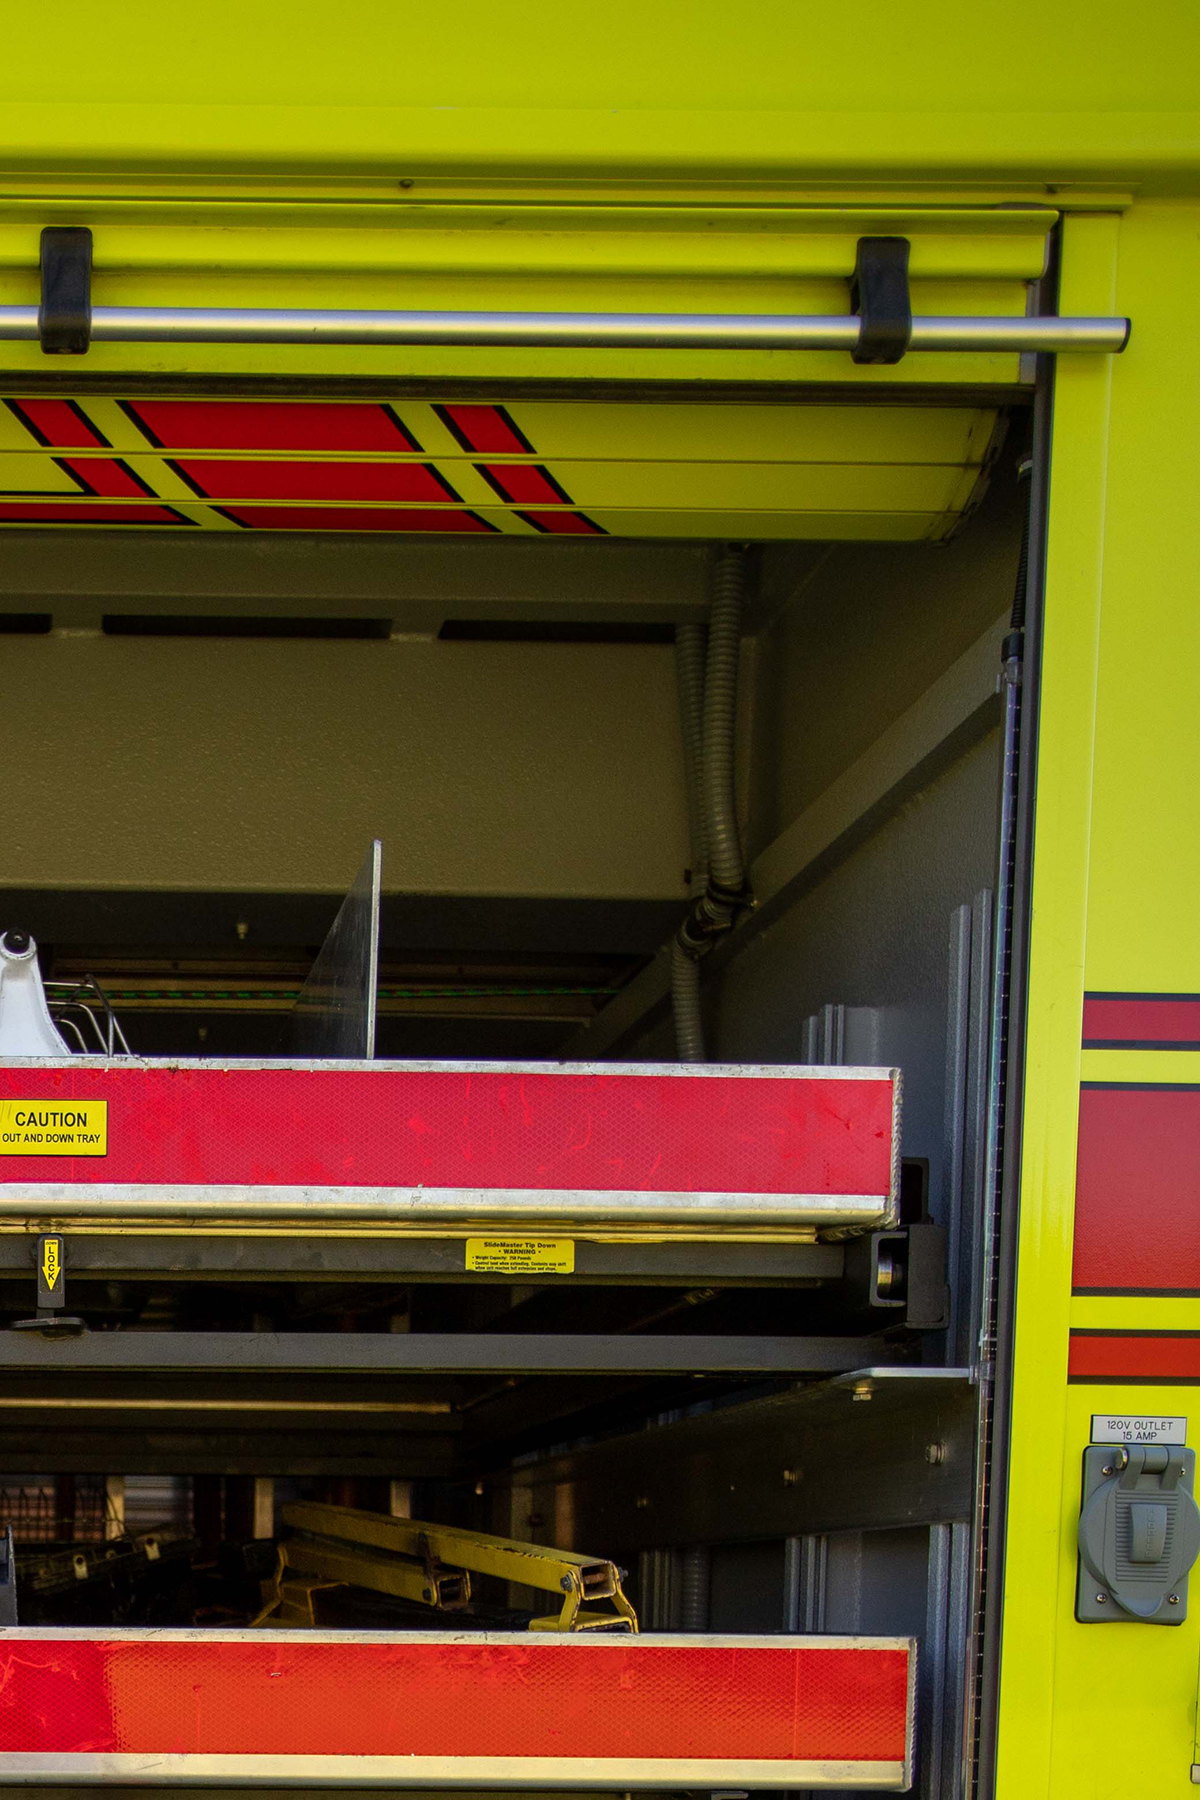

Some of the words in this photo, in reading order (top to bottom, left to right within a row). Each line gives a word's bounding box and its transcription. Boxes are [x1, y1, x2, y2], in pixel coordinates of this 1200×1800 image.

[15, 1112, 88, 1127] CAUTION
[2, 1133, 21, 1142] OUT
[23, 1133, 43, 1143] AND
[46, 1134, 74, 1143] DOWN
[77, 1134, 101, 1143] TRAY
[47, 1246, 55, 1280] LOCK
[1107, 1420, 1131, 1430] 120V
[1133, 1421, 1174, 1431] OUTLET
[1122, 1431, 1132, 1440] 15
[1135, 1432, 1157, 1440] AMP
